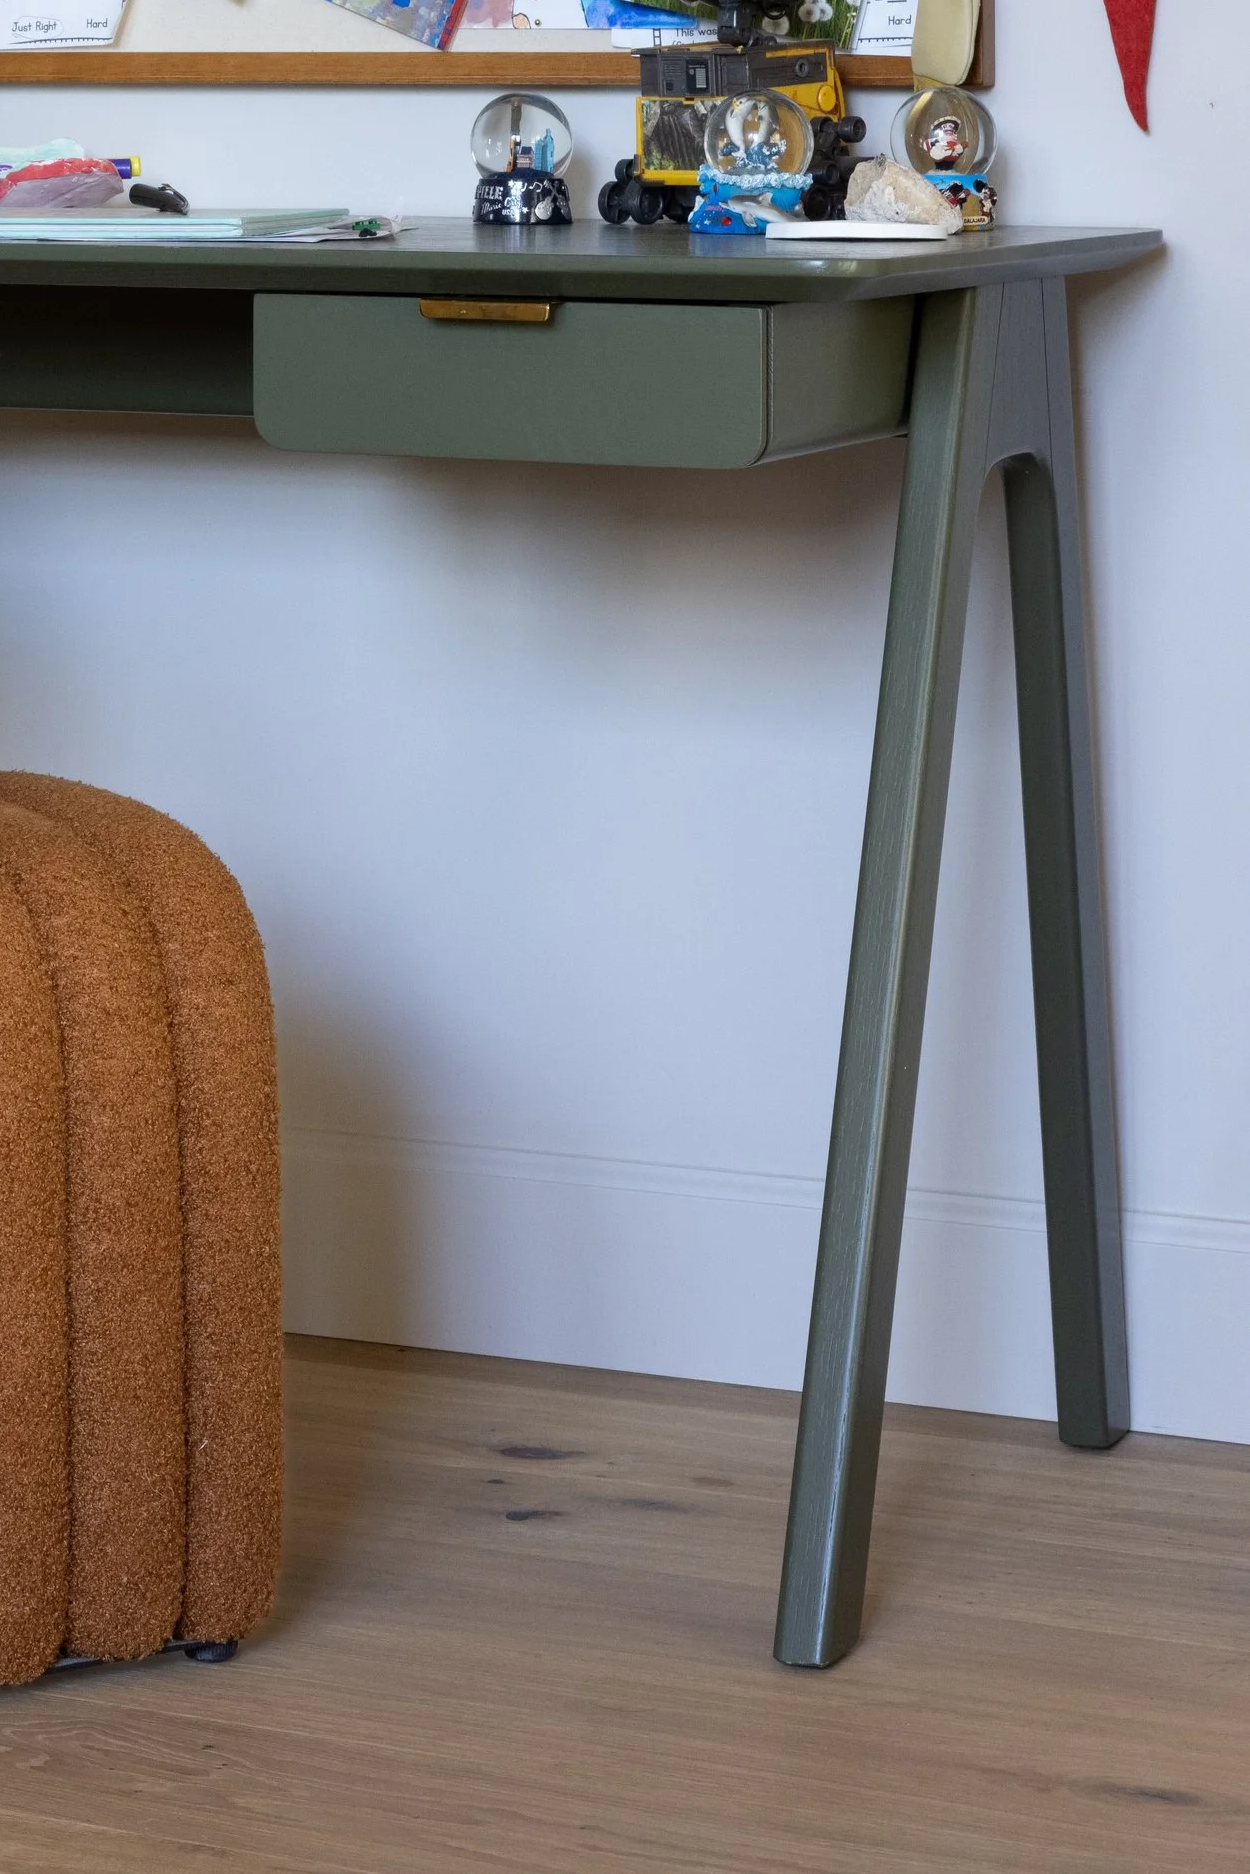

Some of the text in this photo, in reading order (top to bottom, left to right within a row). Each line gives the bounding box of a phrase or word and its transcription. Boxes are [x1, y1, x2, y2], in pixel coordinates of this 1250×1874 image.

[11, 21, 33, 32] Just
[34, 20, 57, 33] Right
[86, 18, 109, 29] Hard
[888, 14, 912, 26] Hard
[676, 28, 718, 37] This was
